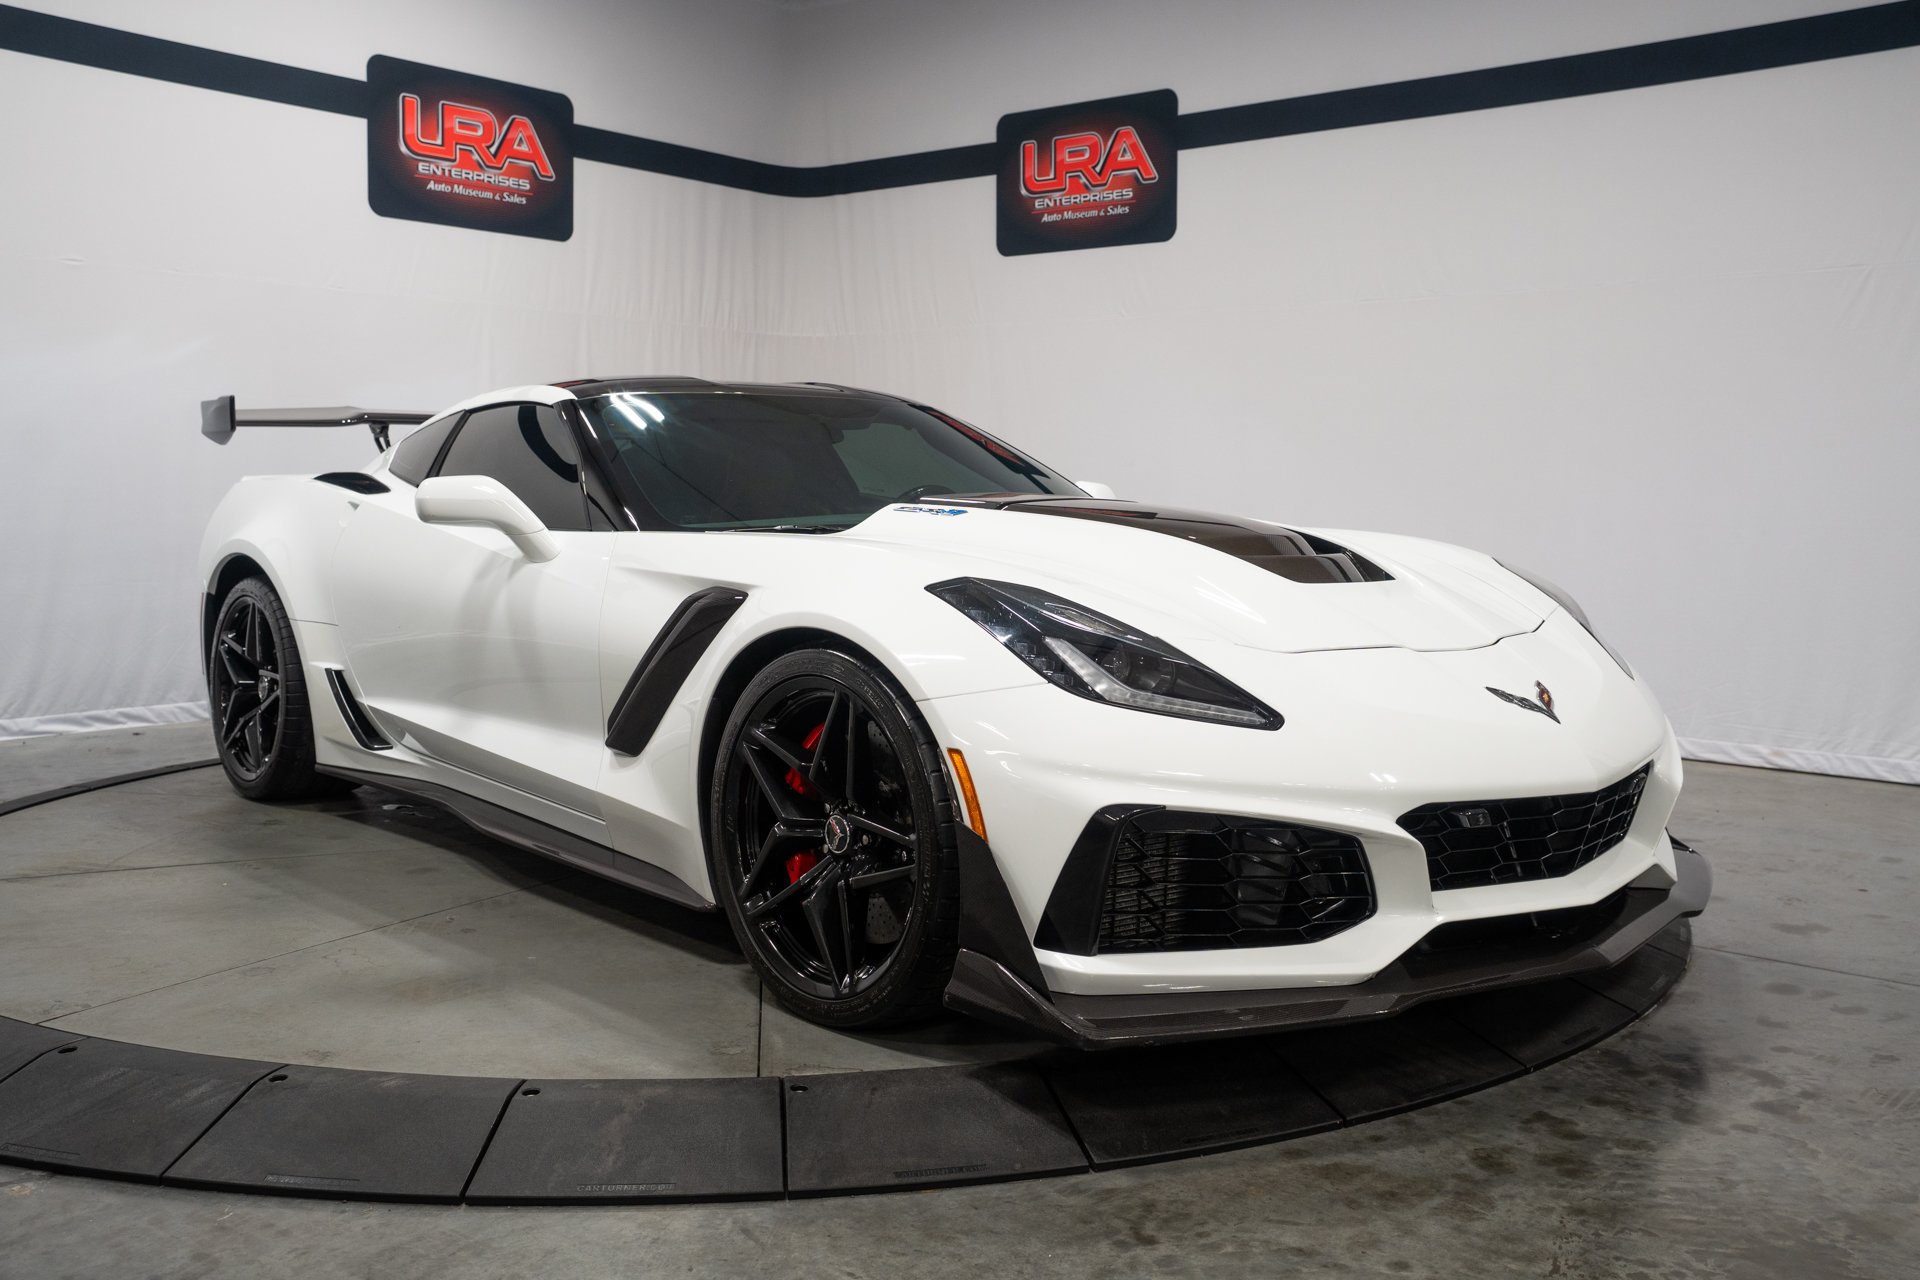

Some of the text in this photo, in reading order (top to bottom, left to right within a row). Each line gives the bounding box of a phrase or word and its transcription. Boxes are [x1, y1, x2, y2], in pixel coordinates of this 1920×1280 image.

[399, 93, 555, 181] URA
[1020, 126, 1158, 197] URA
[419, 163, 530, 190] ENTERPRISES
[426, 181, 451, 193] Auto
[453, 185, 493, 200] Museum
[503, 192, 527, 205] Sales
[1034, 188, 1133, 209] ENTERPRISES
[1041, 213, 1062, 223] Auto
[1063, 207, 1098, 220] Museum
[1107, 205, 1129, 216] Sales
